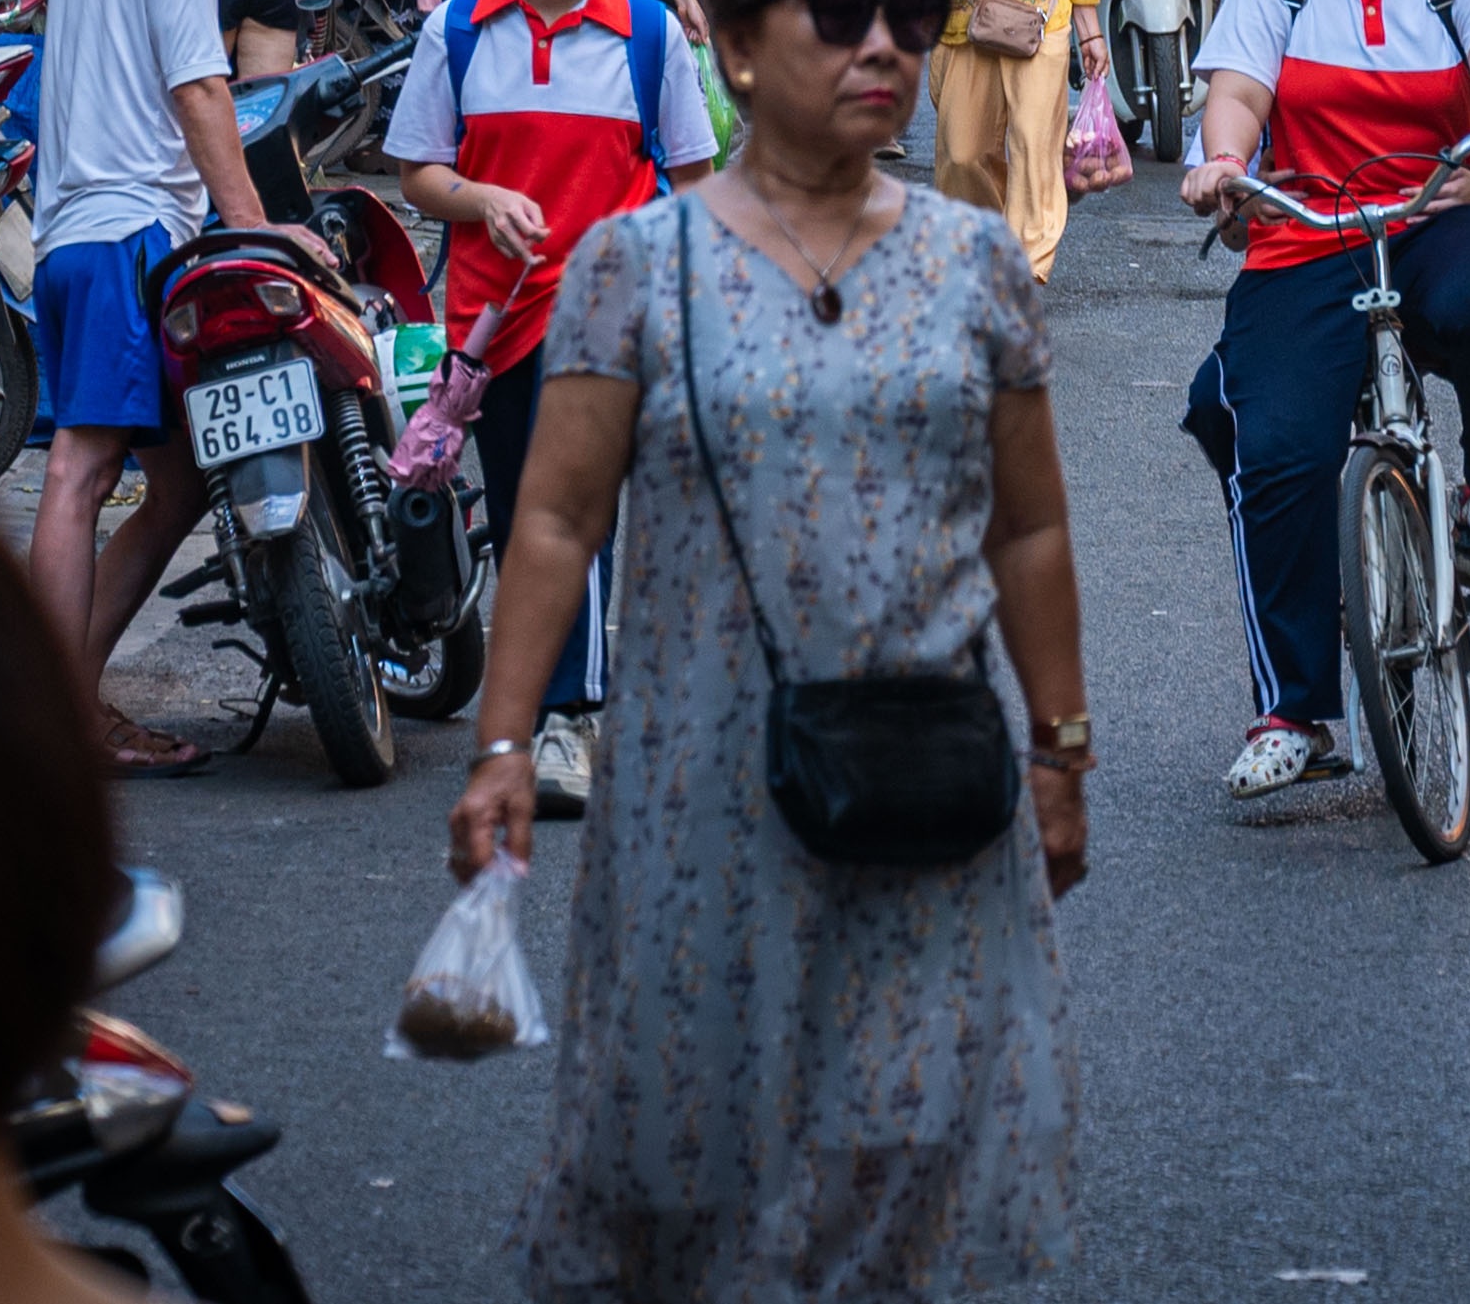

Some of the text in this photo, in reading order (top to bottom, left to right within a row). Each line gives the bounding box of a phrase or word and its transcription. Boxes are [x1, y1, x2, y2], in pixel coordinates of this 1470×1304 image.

[226, 354, 266, 371] HONDA
[205, 370, 293, 421] 29-C1
[201, 403, 312, 459] 664.98
